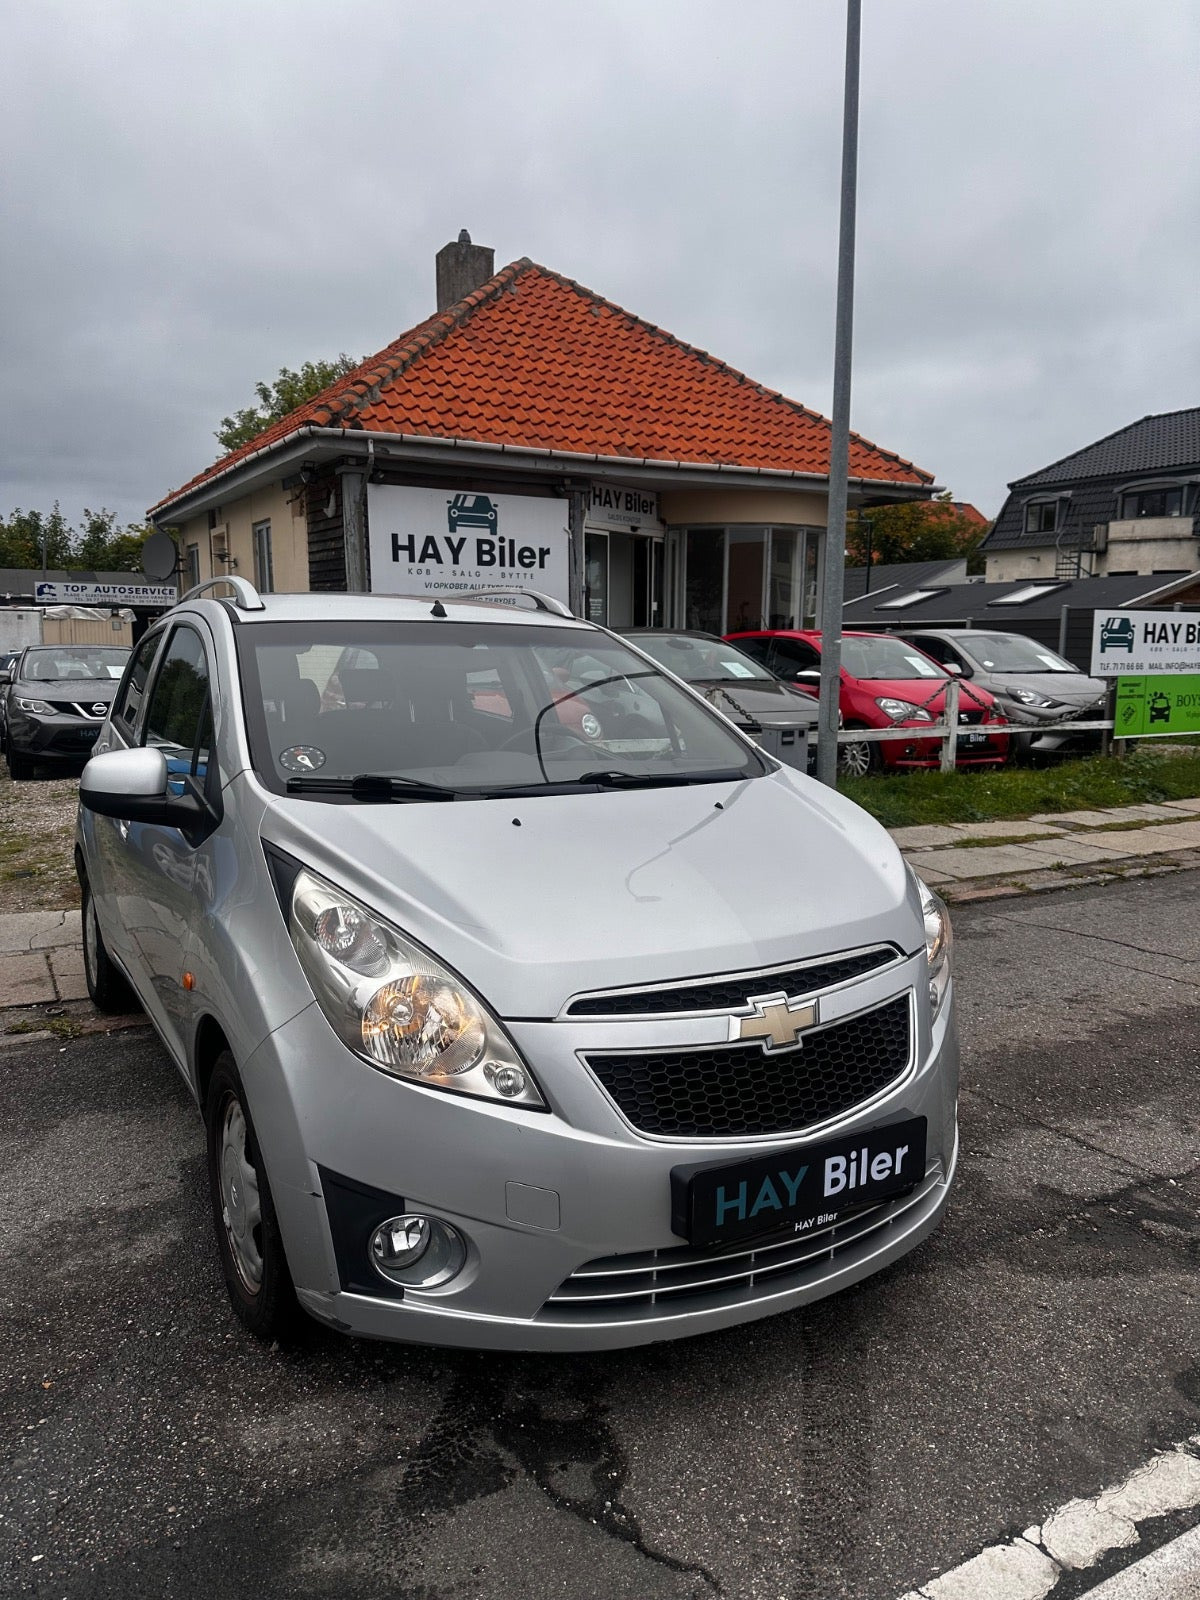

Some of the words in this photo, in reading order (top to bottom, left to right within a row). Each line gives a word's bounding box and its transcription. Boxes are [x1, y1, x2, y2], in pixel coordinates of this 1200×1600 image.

[592, 486, 622, 509] HAY
[625, 491, 655, 515] Biler
[391, 533, 467, 566] HAY
[476, 536, 551, 569] Biler
[408, 568, 431, 576] KØB
[94, 585, 175, 596] AUTOSERVICE
[433, 582, 467, 590] OPKØBER
[1143, 622, 1182, 644] HAY
[80, 729, 100, 737] HAY
[970, 733, 987, 742] Biler
[715, 1165, 809, 1226] HAY
[823, 1144, 909, 1197] Biler
[794, 1219, 815, 1232] HAY
[817, 1212, 838, 1226] Biler
